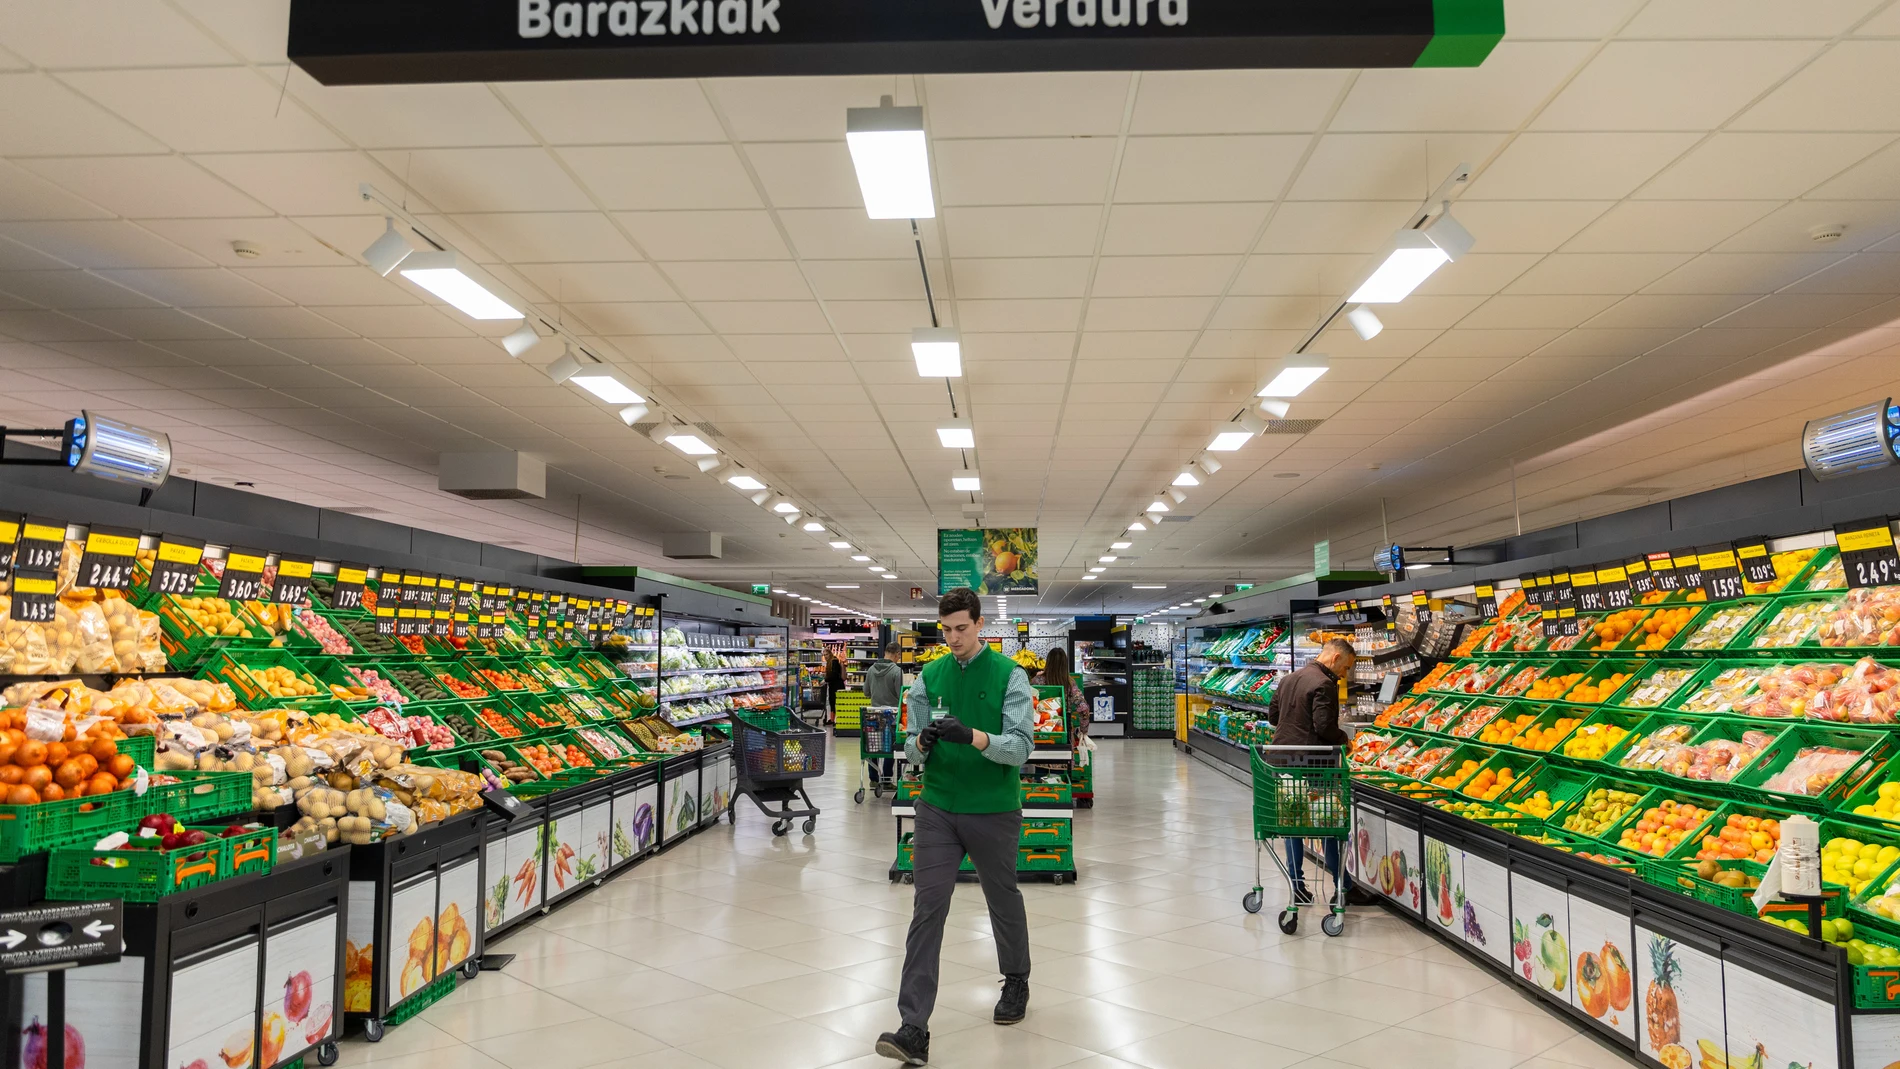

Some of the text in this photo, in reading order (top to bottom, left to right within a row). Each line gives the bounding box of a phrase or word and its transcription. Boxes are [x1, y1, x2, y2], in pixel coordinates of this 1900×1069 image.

[518, 0, 781, 38] Barazkiak
[95, 536, 135, 547] CEBOLLA DULCE
[42, 905, 80, 914] BARAZKIAK
[81, 902, 111, 910] SOLTEAN
[0, 951, 28, 959] FRUTAS
[35, 946, 72, 955] VERDURAS
[79, 942, 106, 950] GRANEL
